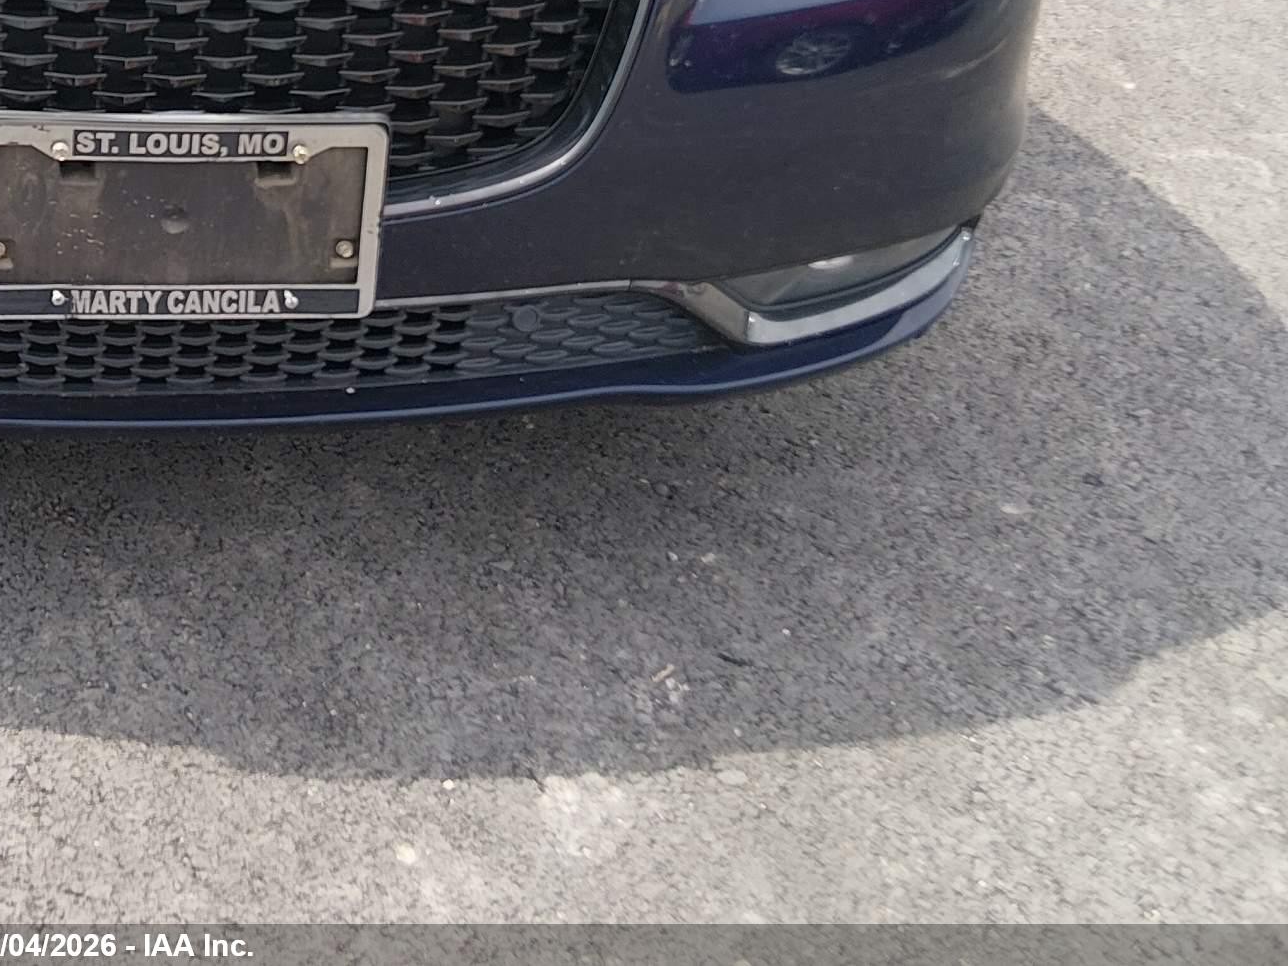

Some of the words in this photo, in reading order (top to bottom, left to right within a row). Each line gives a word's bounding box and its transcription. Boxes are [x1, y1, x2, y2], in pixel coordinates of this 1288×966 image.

[76, 132, 120, 154] ST.
[129, 133, 229, 157] LOUIS,
[238, 134, 286, 155] MO
[71, 290, 165, 314] MARTY
[167, 290, 281, 314] CANCILA
